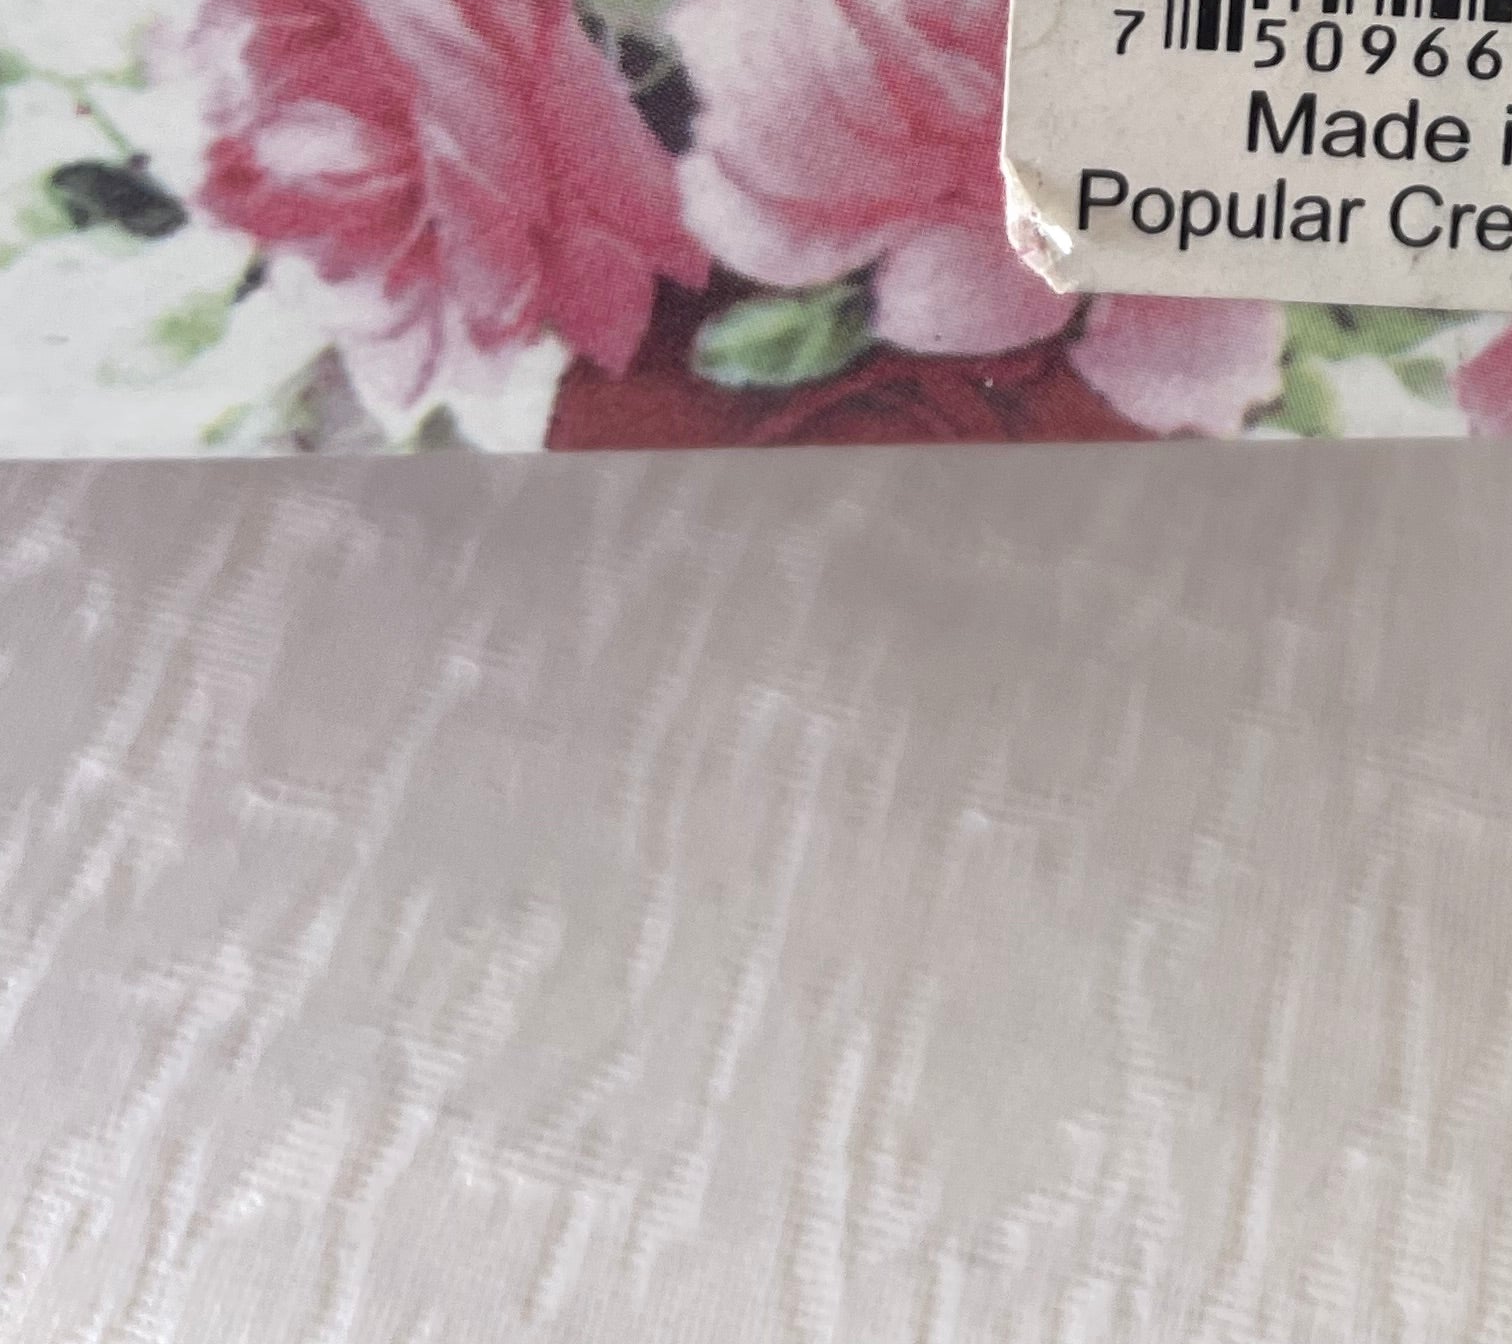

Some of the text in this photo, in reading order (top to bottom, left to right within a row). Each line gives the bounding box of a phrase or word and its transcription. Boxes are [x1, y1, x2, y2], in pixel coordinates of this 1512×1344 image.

[1253, 18, 1503, 81] 50966
[1246, 90, 1471, 164] Made
[1077, 168, 1366, 252] Popular
